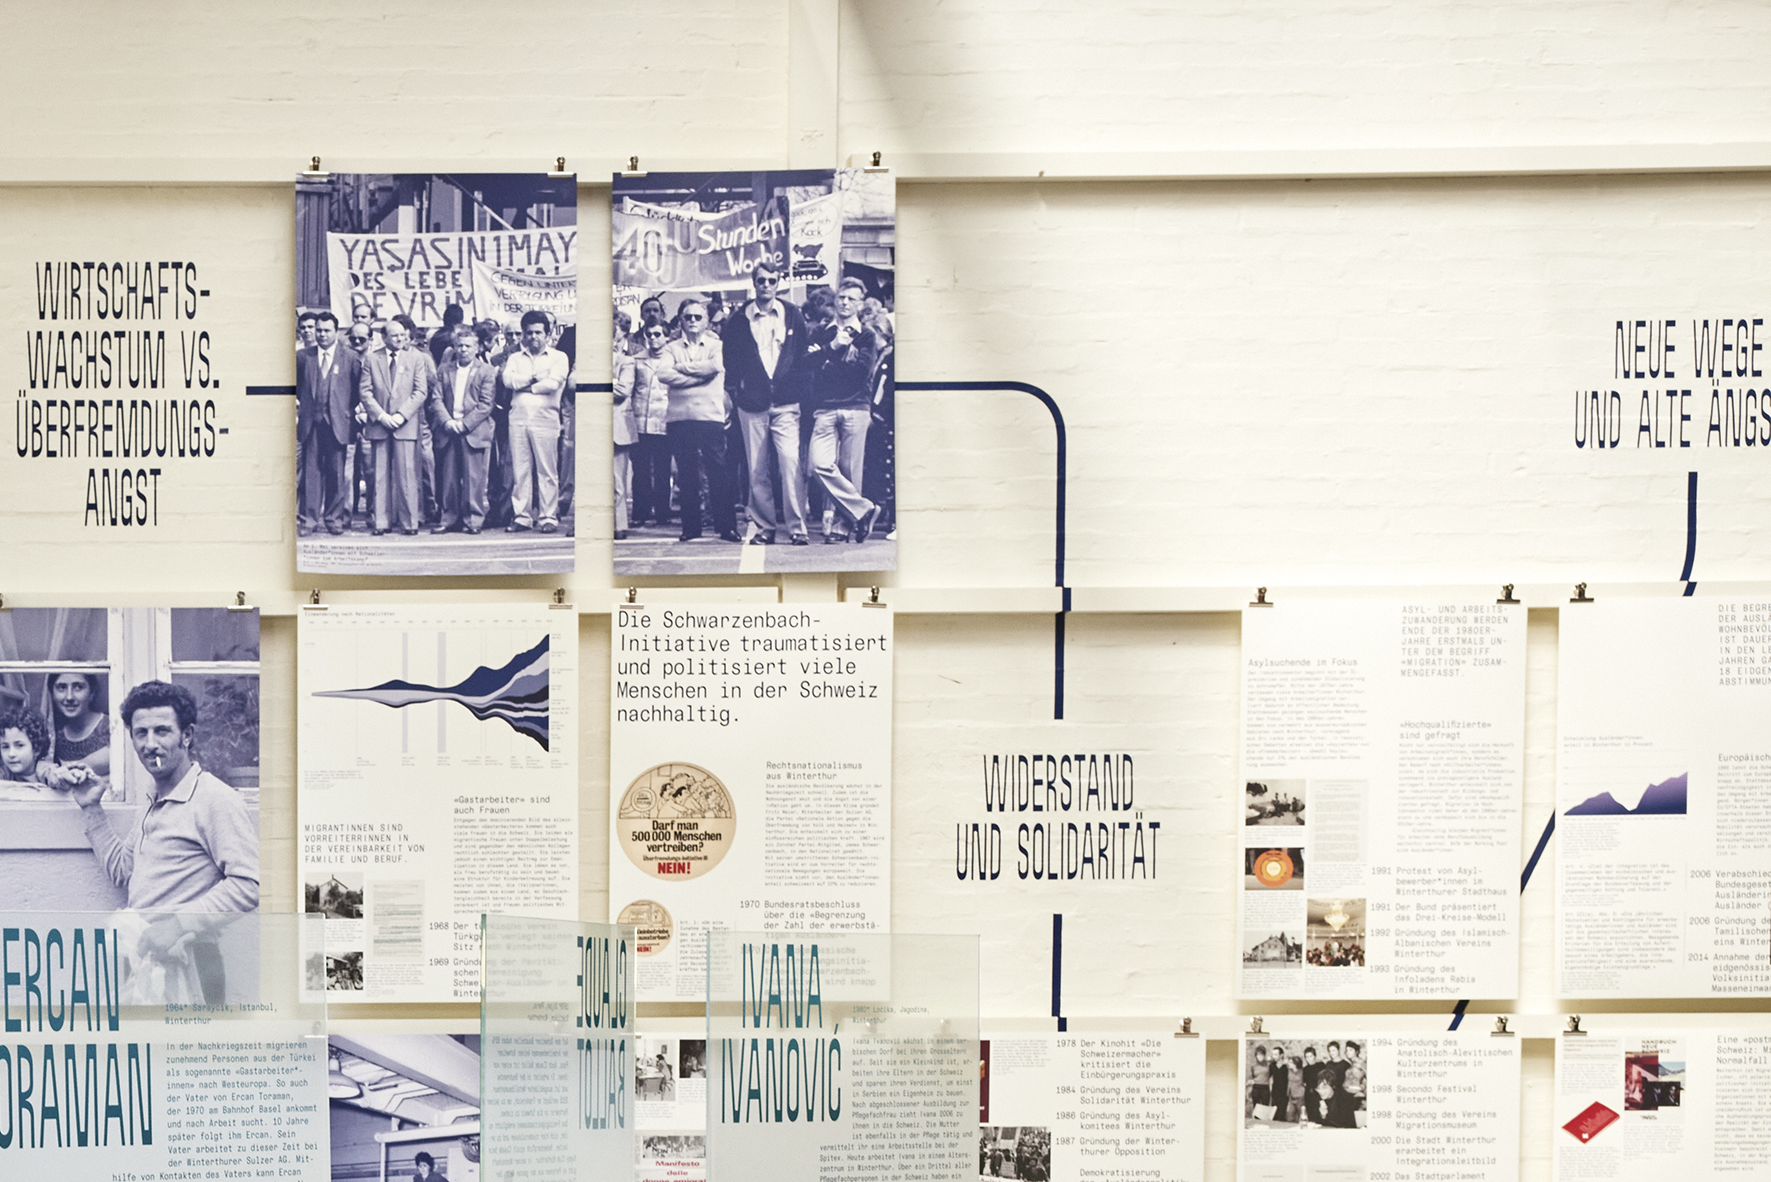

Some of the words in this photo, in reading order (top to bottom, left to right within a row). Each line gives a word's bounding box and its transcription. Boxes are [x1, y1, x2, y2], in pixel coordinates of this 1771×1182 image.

[698, 212, 786, 254] Stunden
[36, 261, 210, 320] WIRTSCHAFTS-
[1615, 320, 1676, 379] NEUE
[1693, 318, 1764, 378] WEGE
[27, 330, 165, 389] WACHSTUM
[181, 331, 220, 389] VS.
[16, 389, 229, 458] ÜBERFREMDUNGS-
[1575, 390, 1621, 449] UND
[1637, 389, 1692, 448] ALTE
[84, 468, 161, 526] ANGST
[618, 610, 651, 628] Die
[663, 610, 820, 629] Schwarzenbach-
[621, 634, 730, 652] Initiative
[740, 633, 887, 652] traumatisiert
[618, 658, 650, 675] und
[663, 658, 786, 679] politisiert
[800, 657, 856, 675] viele
[1248, 658, 1311, 668] Asylsuchende
[1332, 657, 1358, 666] Fokus
[617, 681, 707, 699] Menschen
[721, 681, 741, 699] in
[753, 681, 787, 699] der
[800, 680, 877, 698] Schweiz
[617, 704, 738, 727] nachhaltig.
[1400, 731, 1420, 739] sind
[1425, 730, 1460, 741] gefragt
[766, 761, 862, 770] Rechtsnationalismus
[786, 772, 837, 780] Winterthur
[983, 754, 1133, 812] WIDERSTAND
[304, 823, 374, 832] MIGRANTINNEN
[380, 823, 403, 832] SIND
[652, 820, 675, 831] Darf
[677, 822, 699, 831] man
[673, 830, 722, 842] Menschen
[647, 842, 704, 852] vertreiben?
[956, 823, 1001, 881] UND
[1018, 812, 1161, 880] SOLIDARITÄT
[658, 862, 690, 874] NEIN!
[1688, 953, 1709, 961] 2014
[1713, 953, 1750, 961] Annahme
[3, 927, 120, 1033] ERCAN
[742, 943, 823, 1029] IVANA
[721, 1023, 842, 1124] IVANOVIĆ
[1372, 1085, 1392, 1093] 1998
[1396, 1085, 1433, 1093] Secondo
[1437, 1084, 1477, 1093] Festival
[1080, 1096, 1135, 1105] Solidarität
[1140, 1096, 1191, 1104] Winterthur
